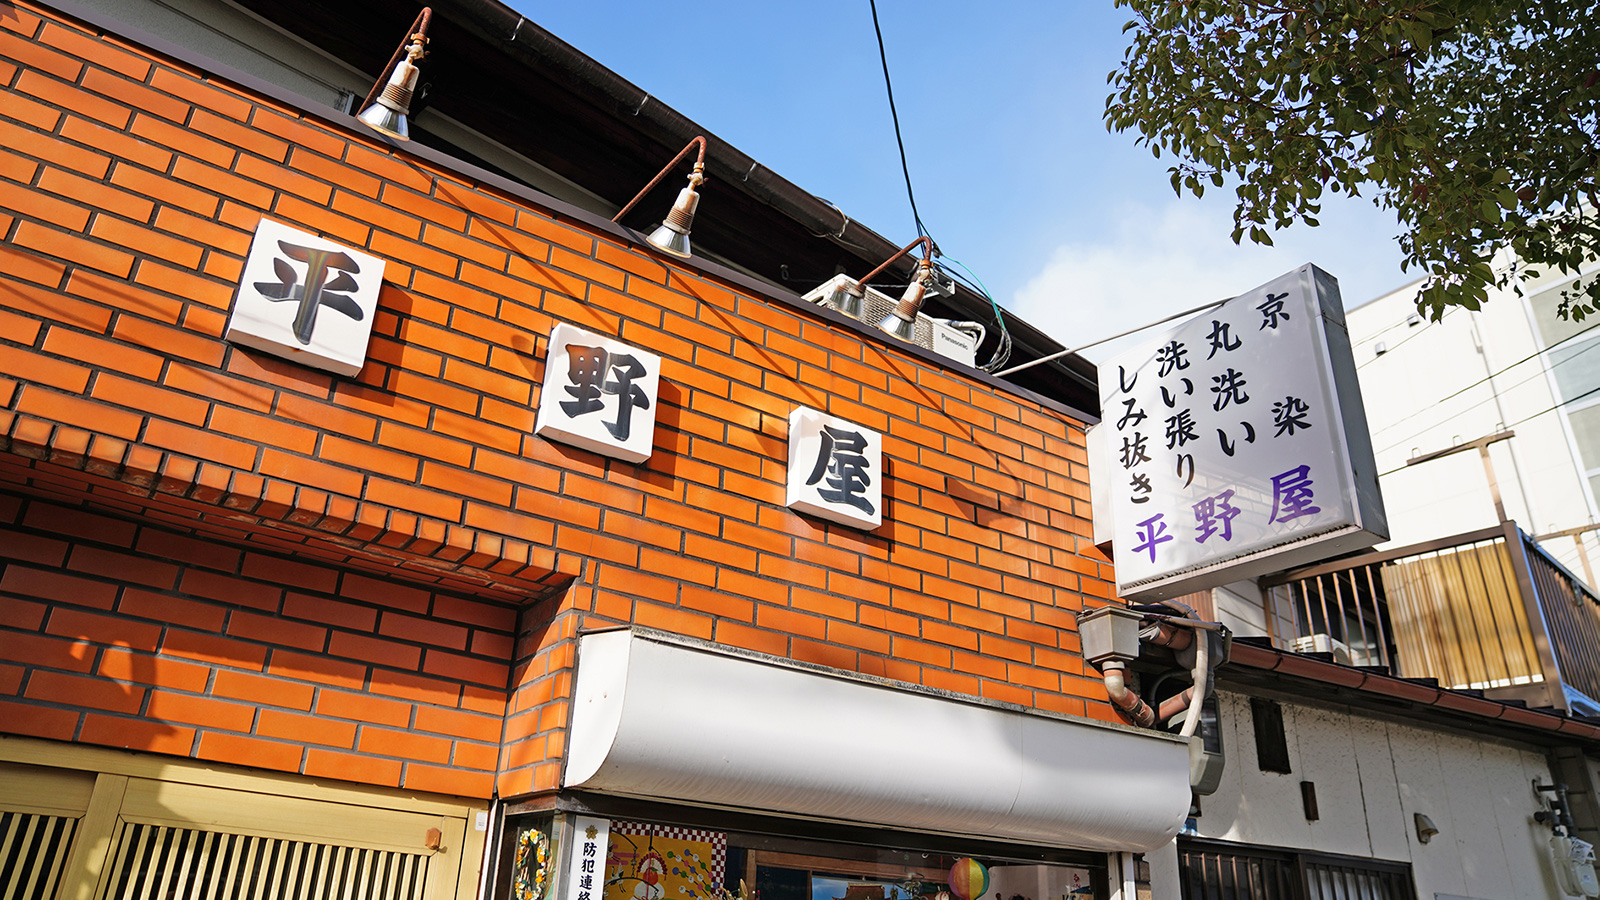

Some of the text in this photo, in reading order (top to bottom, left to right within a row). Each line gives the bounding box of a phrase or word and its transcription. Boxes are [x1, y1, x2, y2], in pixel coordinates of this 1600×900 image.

[941, 332, 969, 350] Panasonic
[1206, 320, 1255, 456] 丸洗い
[1116, 365, 1152, 504] しみ抜き
[1156, 340, 1200, 489] 洗い張り
[1131, 464, 1321, 564] 平野屋
